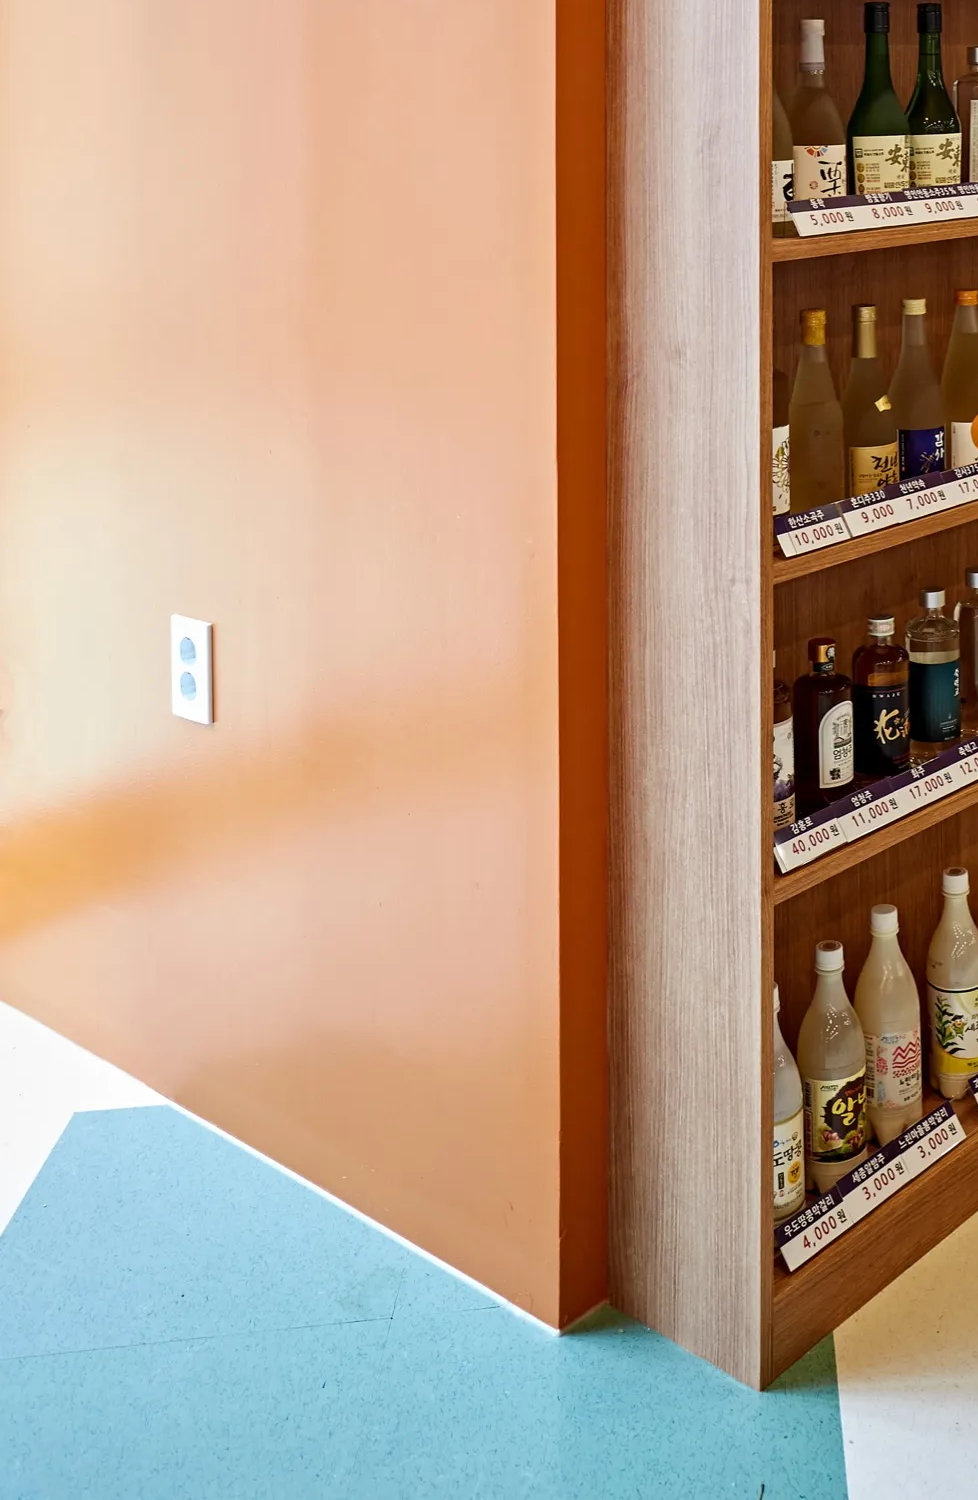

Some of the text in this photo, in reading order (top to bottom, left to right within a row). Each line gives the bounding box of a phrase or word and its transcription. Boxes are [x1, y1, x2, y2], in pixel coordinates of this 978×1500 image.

[810, 210, 854, 227] 5,000원
[872, 205, 914, 220] 8,000원
[924, 200, 964, 214] 9,000원
[906, 490, 946, 511] 7,000원
[787, 509, 825, 529] 한산소곡주
[860, 504, 894, 524] 9,000
[794, 522, 844, 546] 10,000원
[908, 771, 954, 800] 17,000원
[789, 816, 814, 835] 감홍로
[851, 798, 899, 827] 11,000원
[792, 824, 840, 856] 40,000원
[916, 1122, 958, 1159] 3,000원
[851, 1152, 886, 1184] 세종알밤주
[862, 1161, 905, 1202] 3,000원
[783, 1193, 835, 1238] 우도땅콩막걸리
[803, 1209, 847, 1251] 4,000원
